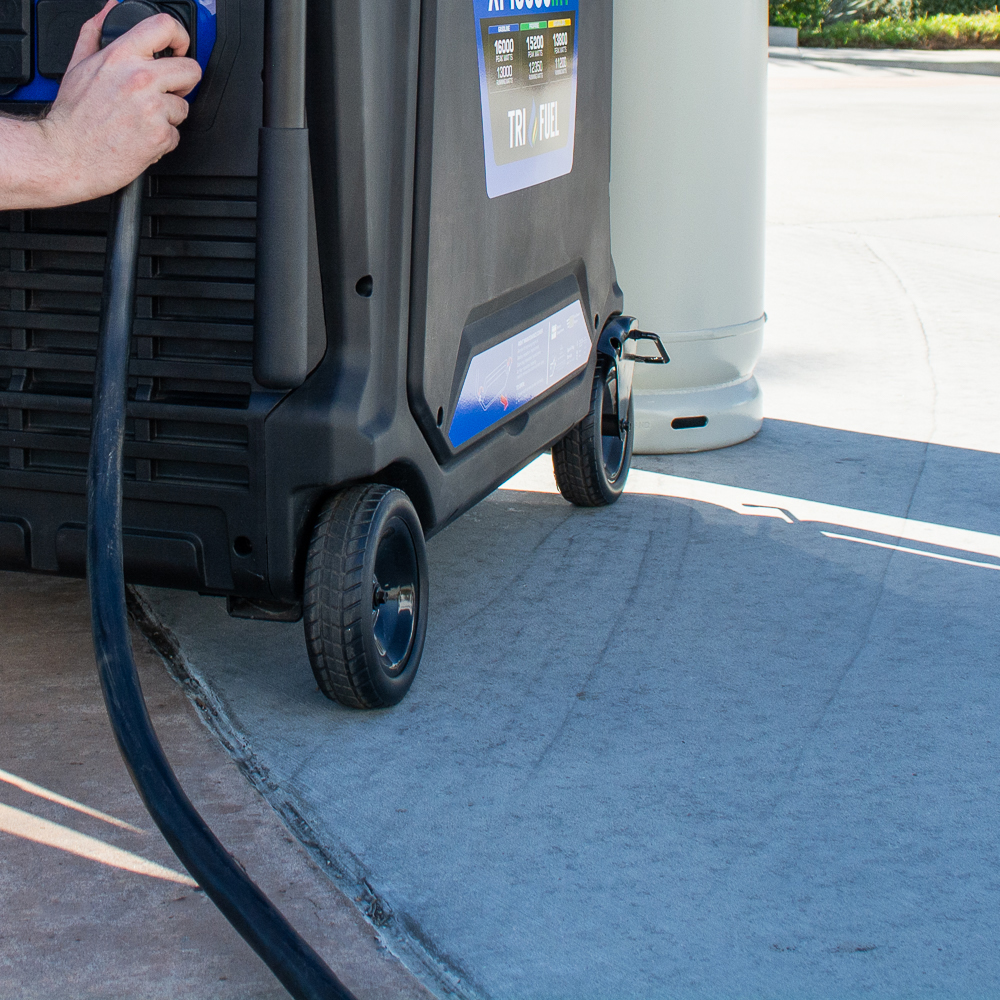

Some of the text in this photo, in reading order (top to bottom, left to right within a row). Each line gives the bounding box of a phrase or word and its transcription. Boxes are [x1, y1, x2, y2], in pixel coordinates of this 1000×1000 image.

[494, 38, 514, 54] 16000
[526, 35, 544, 50] 15200
[553, 32, 567, 46] 13800
[497, 65, 512, 78] 13000
[529, 60, 542, 73] 12350
[507, 101, 560, 149] TRI FUEL
